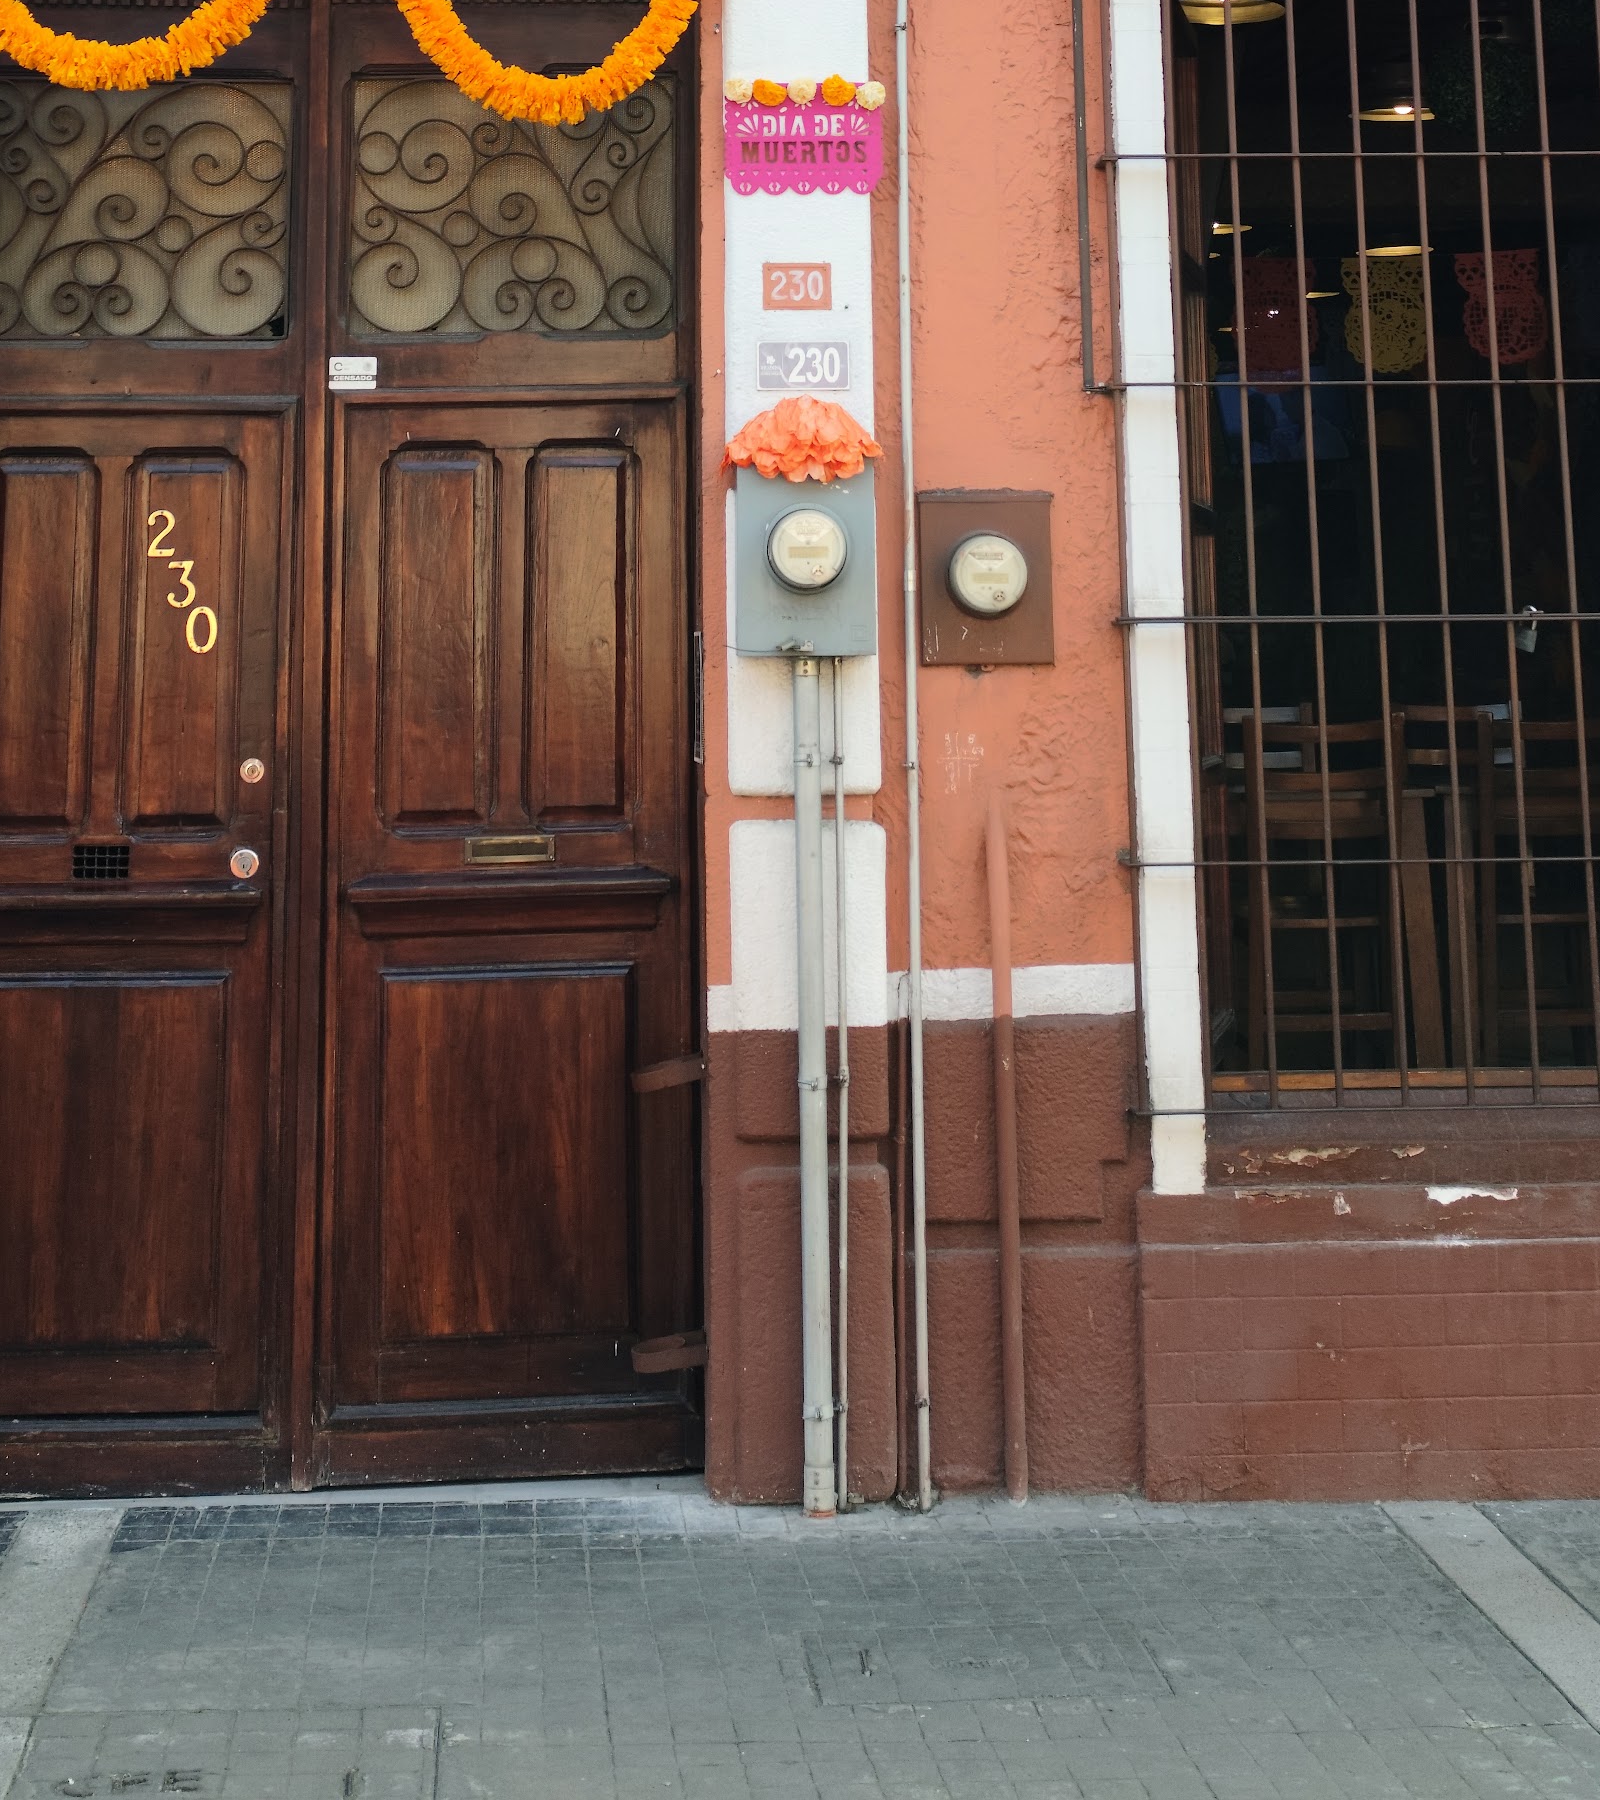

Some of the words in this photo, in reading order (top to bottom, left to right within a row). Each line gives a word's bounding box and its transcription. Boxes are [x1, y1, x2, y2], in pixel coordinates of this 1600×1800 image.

[813, 114, 846, 137] DE
[741, 140, 868, 164] MUERTOS
[770, 270, 824, 301] 230
[788, 347, 841, 383] 230
